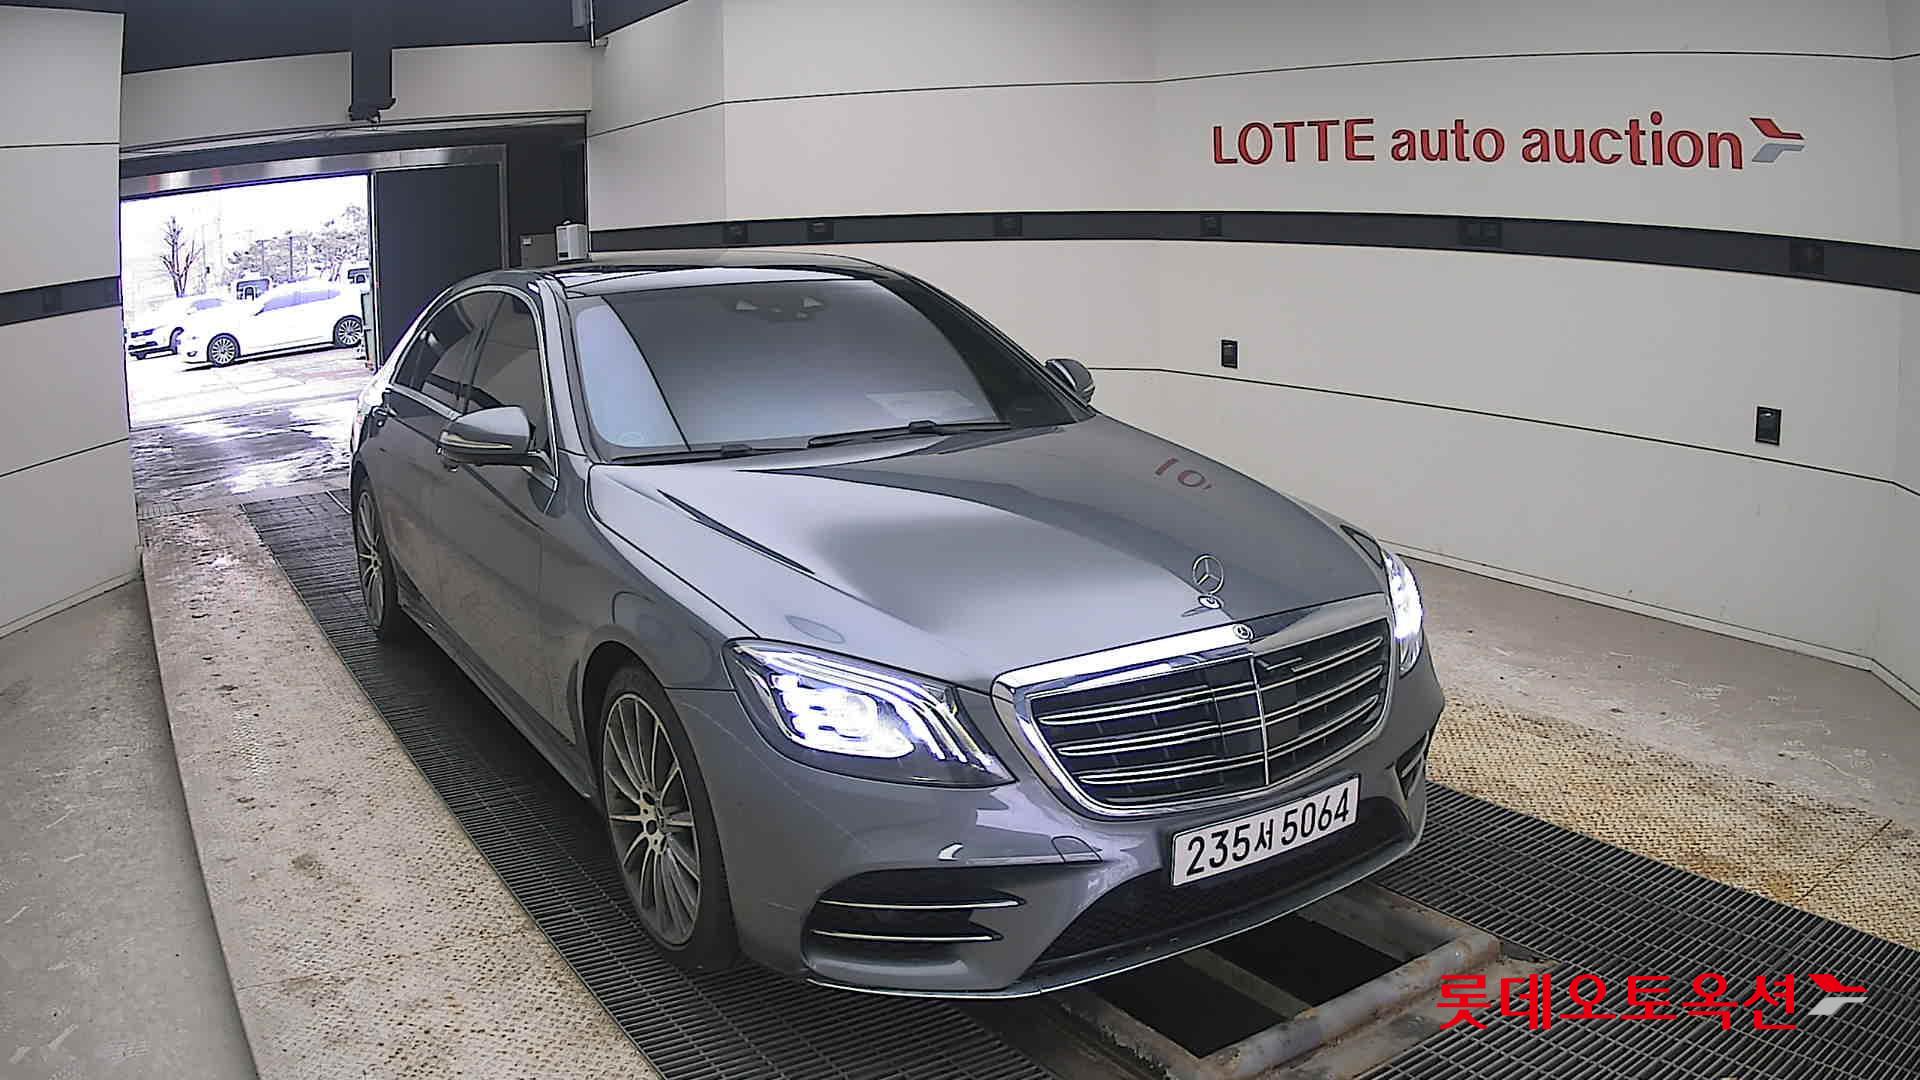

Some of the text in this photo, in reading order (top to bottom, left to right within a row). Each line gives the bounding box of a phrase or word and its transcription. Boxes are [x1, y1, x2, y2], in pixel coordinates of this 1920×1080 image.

[1212, 111, 1744, 170] LOTTE auto auction
